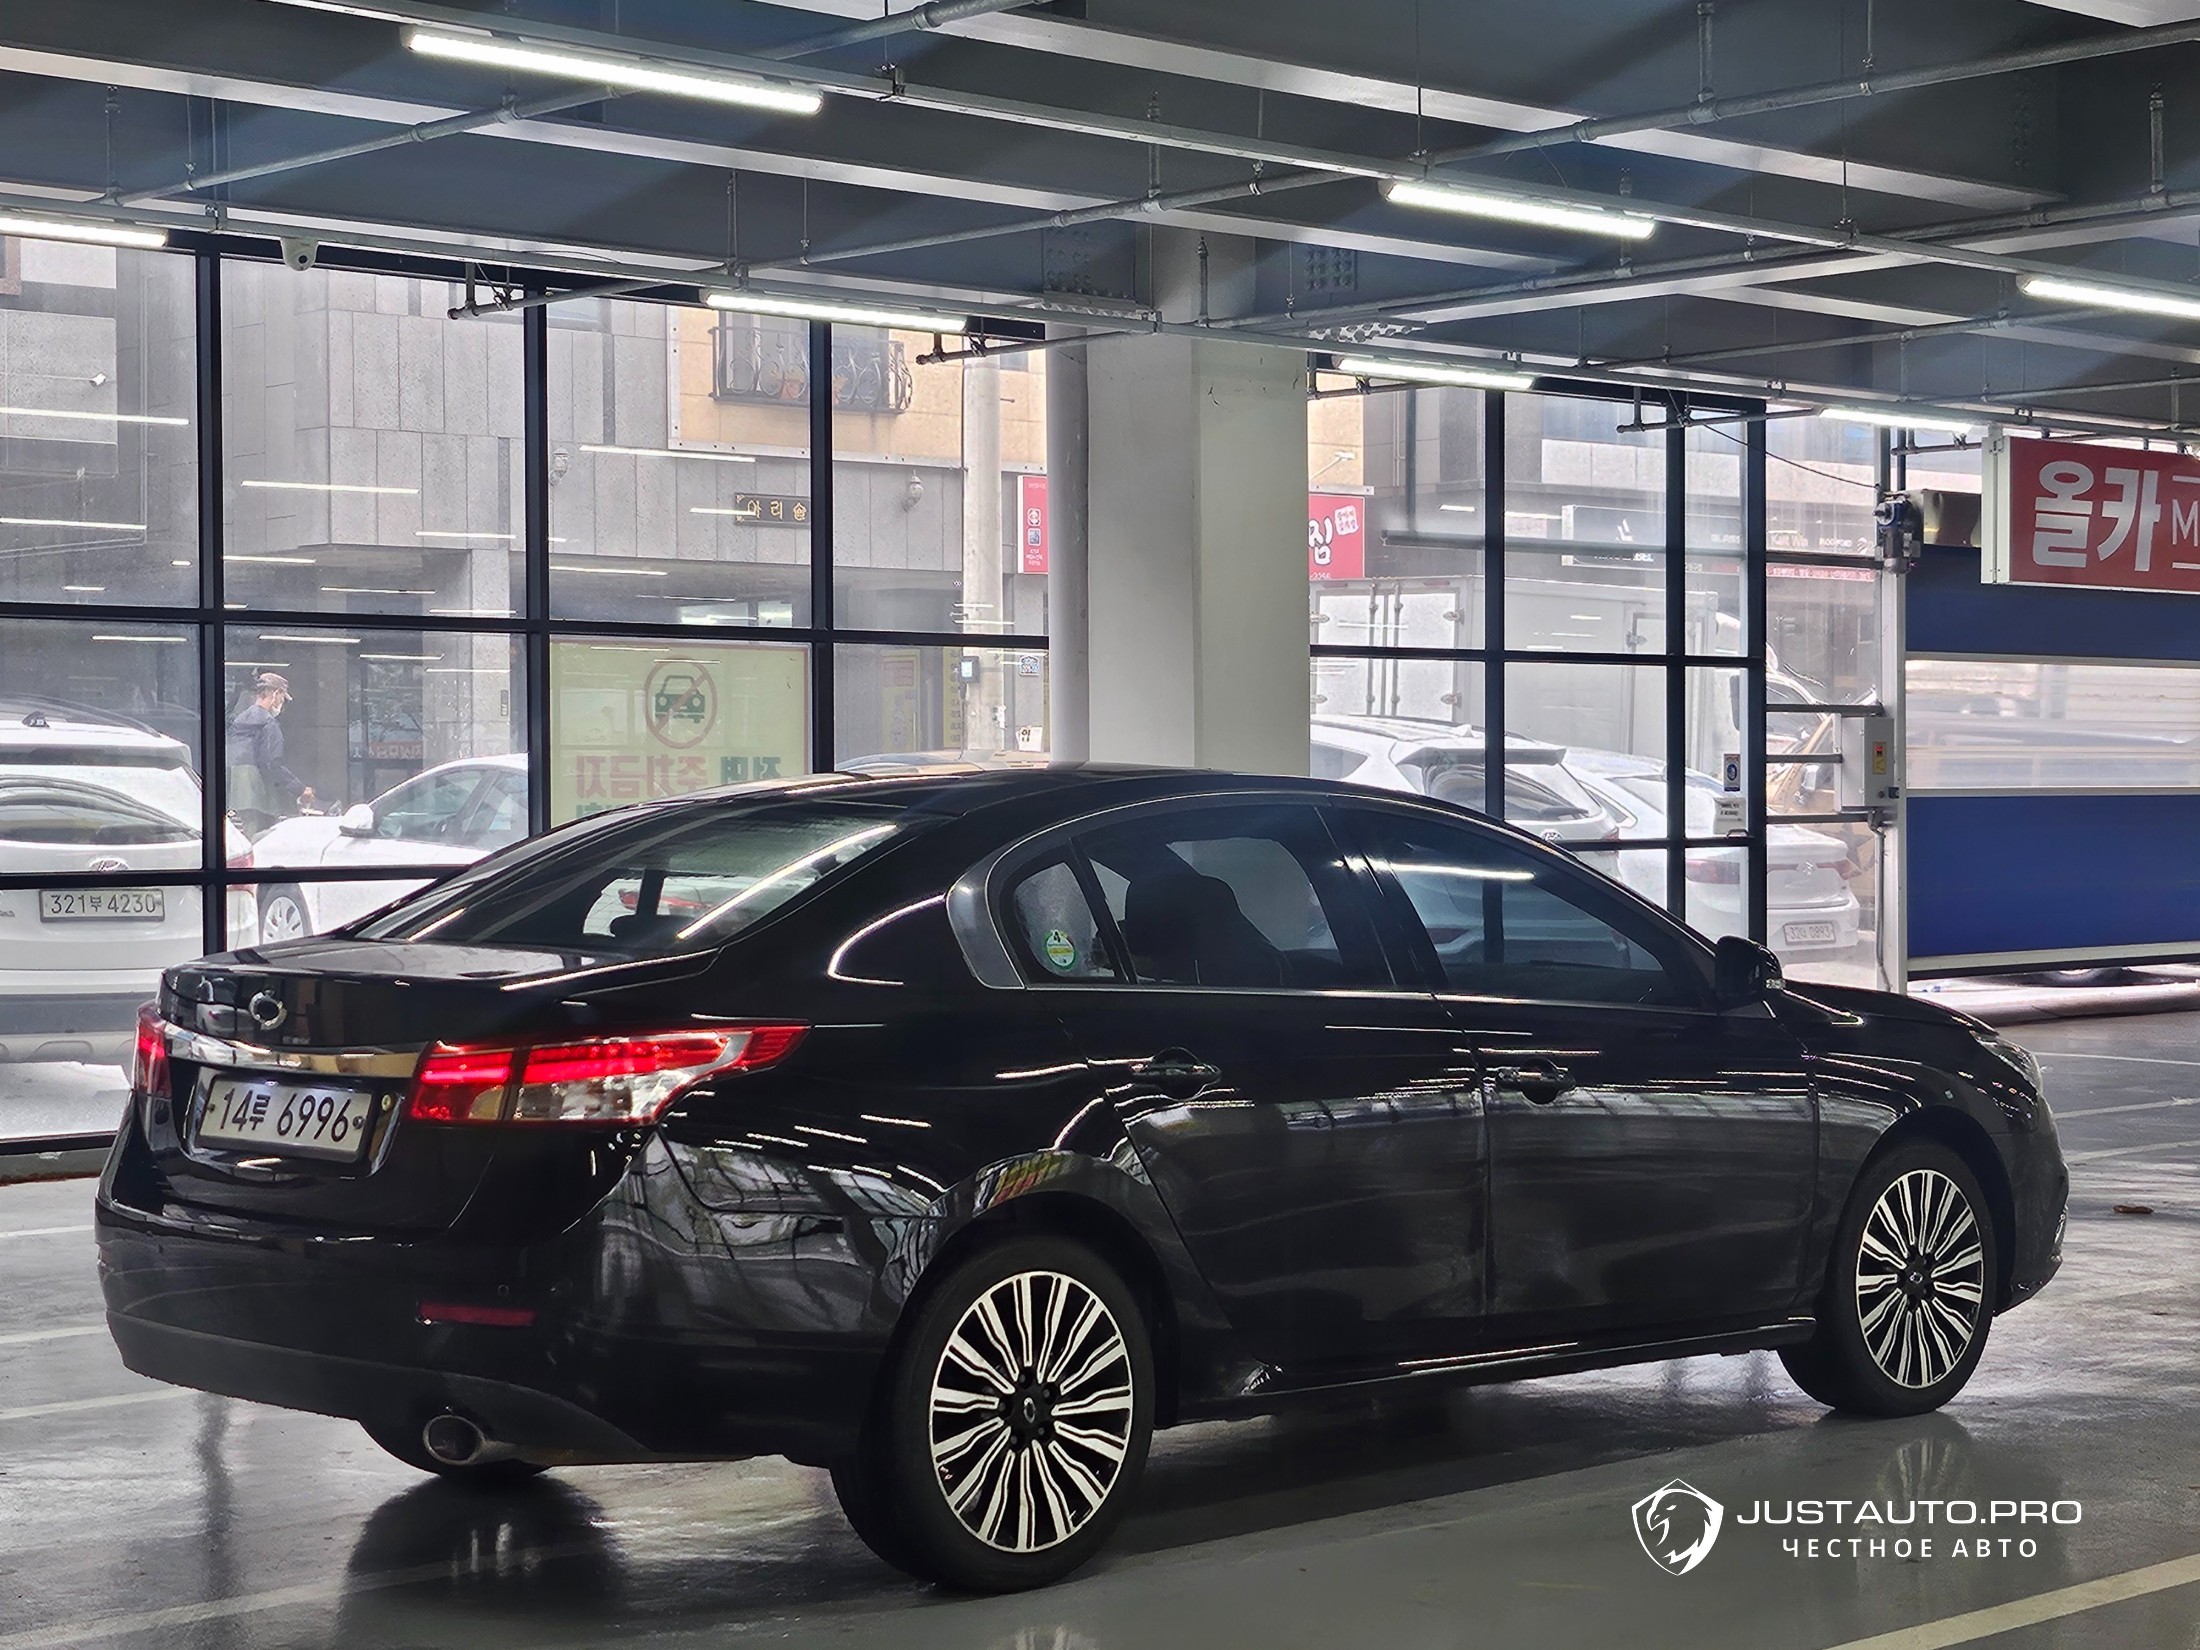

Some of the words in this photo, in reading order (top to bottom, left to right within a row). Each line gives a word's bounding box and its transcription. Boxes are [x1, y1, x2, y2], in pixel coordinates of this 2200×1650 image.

[2032, 460, 2162, 572] 올카
[2172, 498, 2199, 547] M
[50, 894, 102, 914] 321부
[107, 893, 156, 913] 4230
[219, 1087, 271, 1132] 14루
[276, 1092, 352, 1143] 6996
